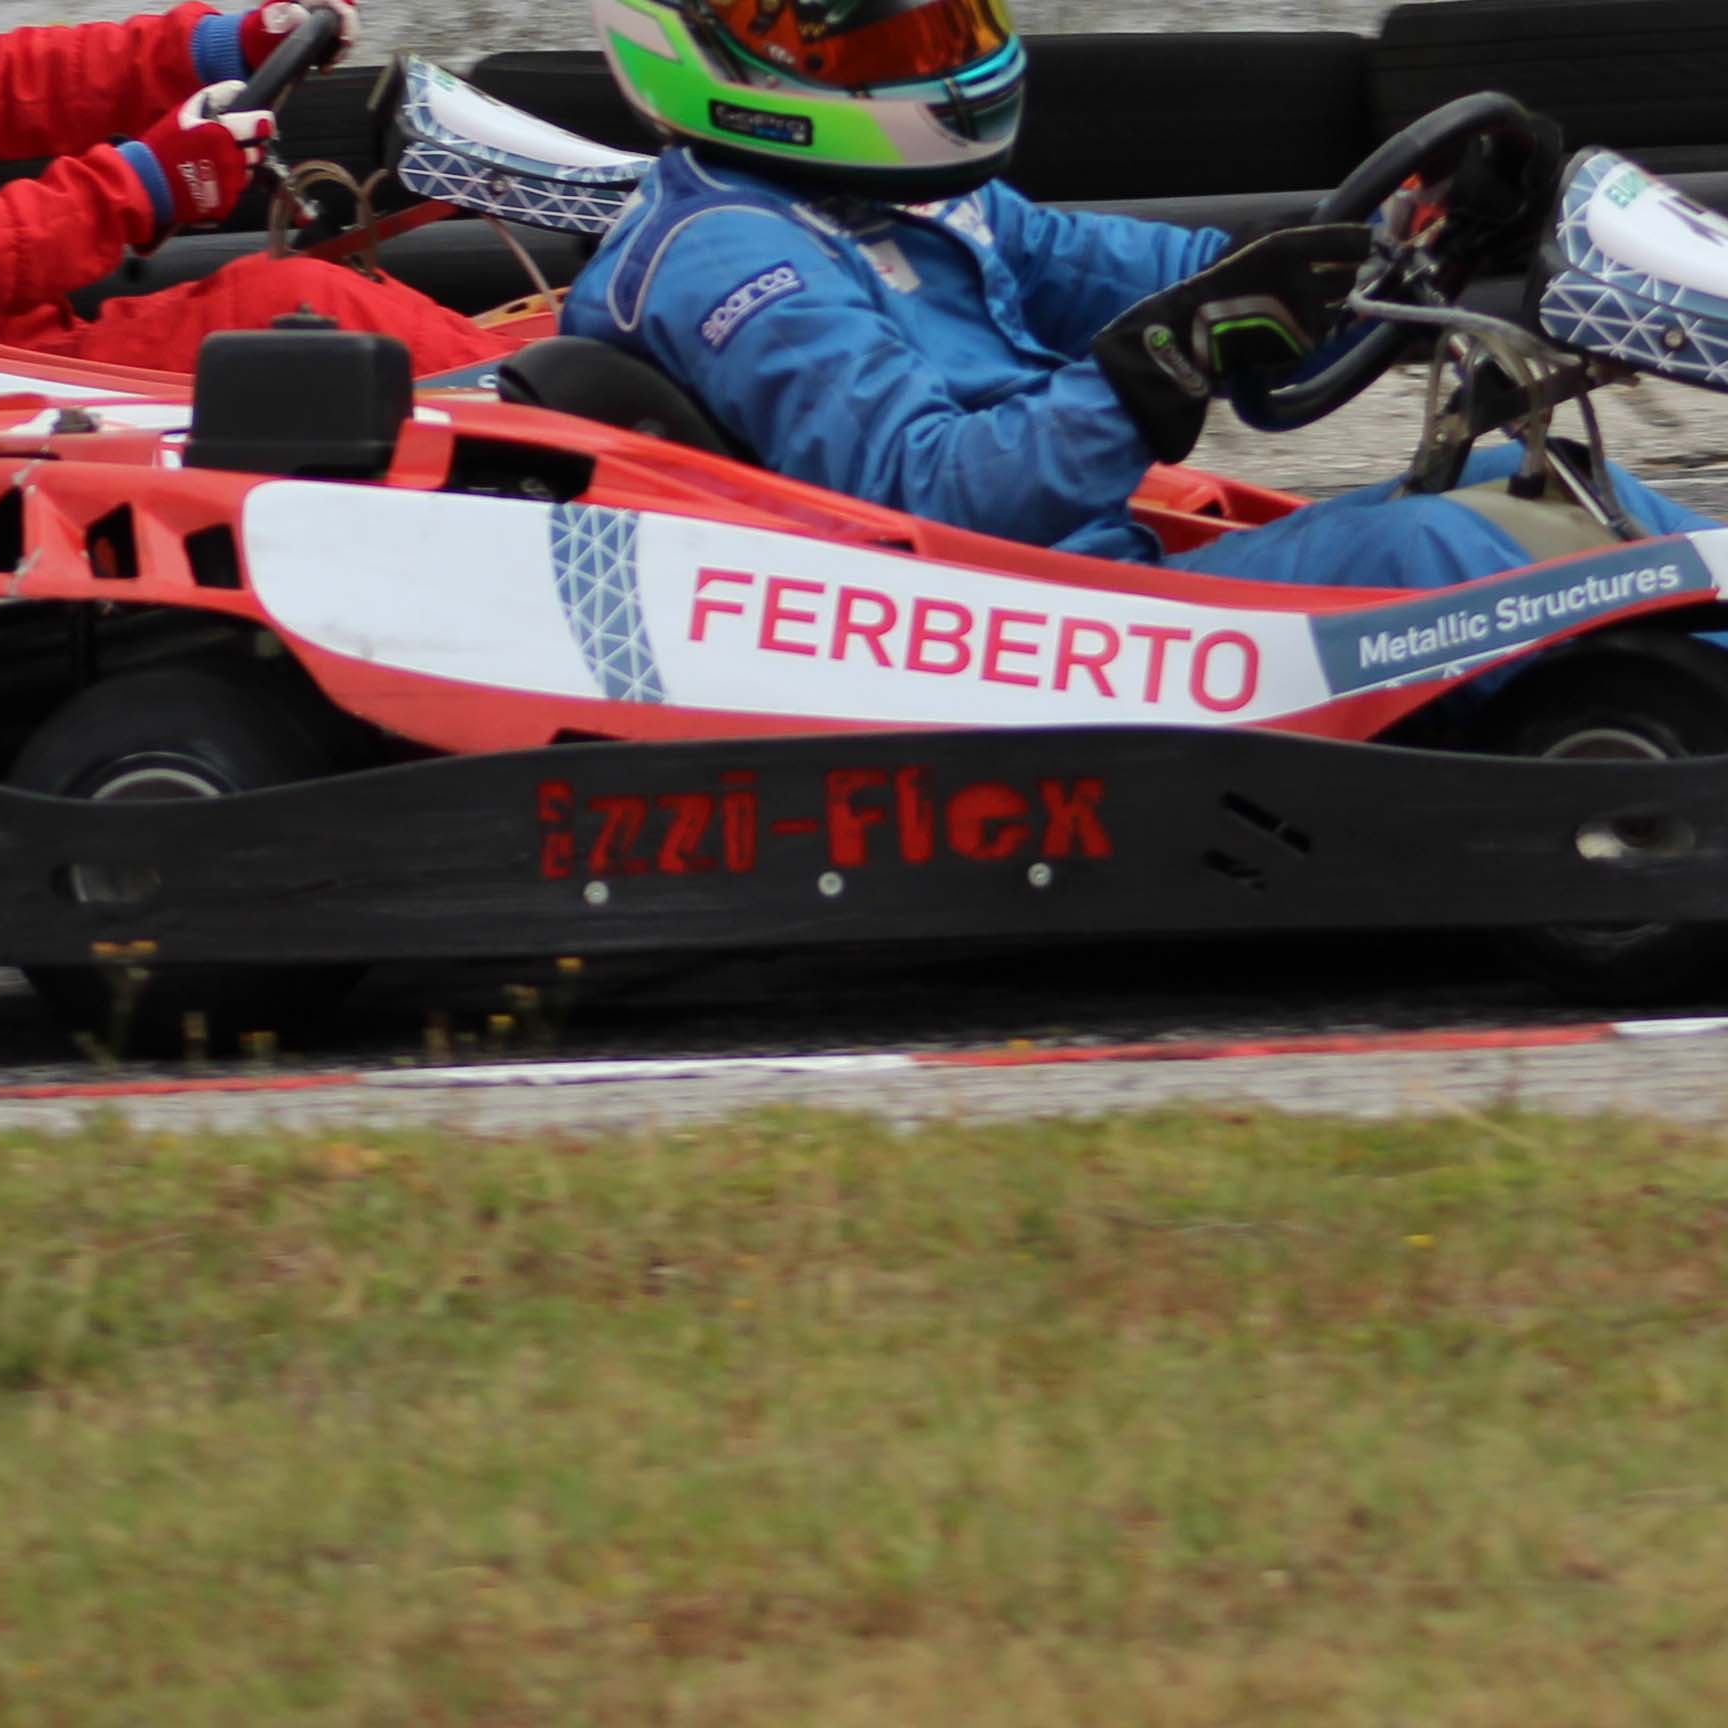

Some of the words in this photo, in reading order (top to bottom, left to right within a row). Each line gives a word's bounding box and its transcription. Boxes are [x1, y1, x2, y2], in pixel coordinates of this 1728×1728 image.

[702, 266, 800, 347] sparco
[689, 568, 1260, 712] FERBERTO
[1358, 610, 1489, 669] Metallic
[1494, 563, 1681, 632] Structures
